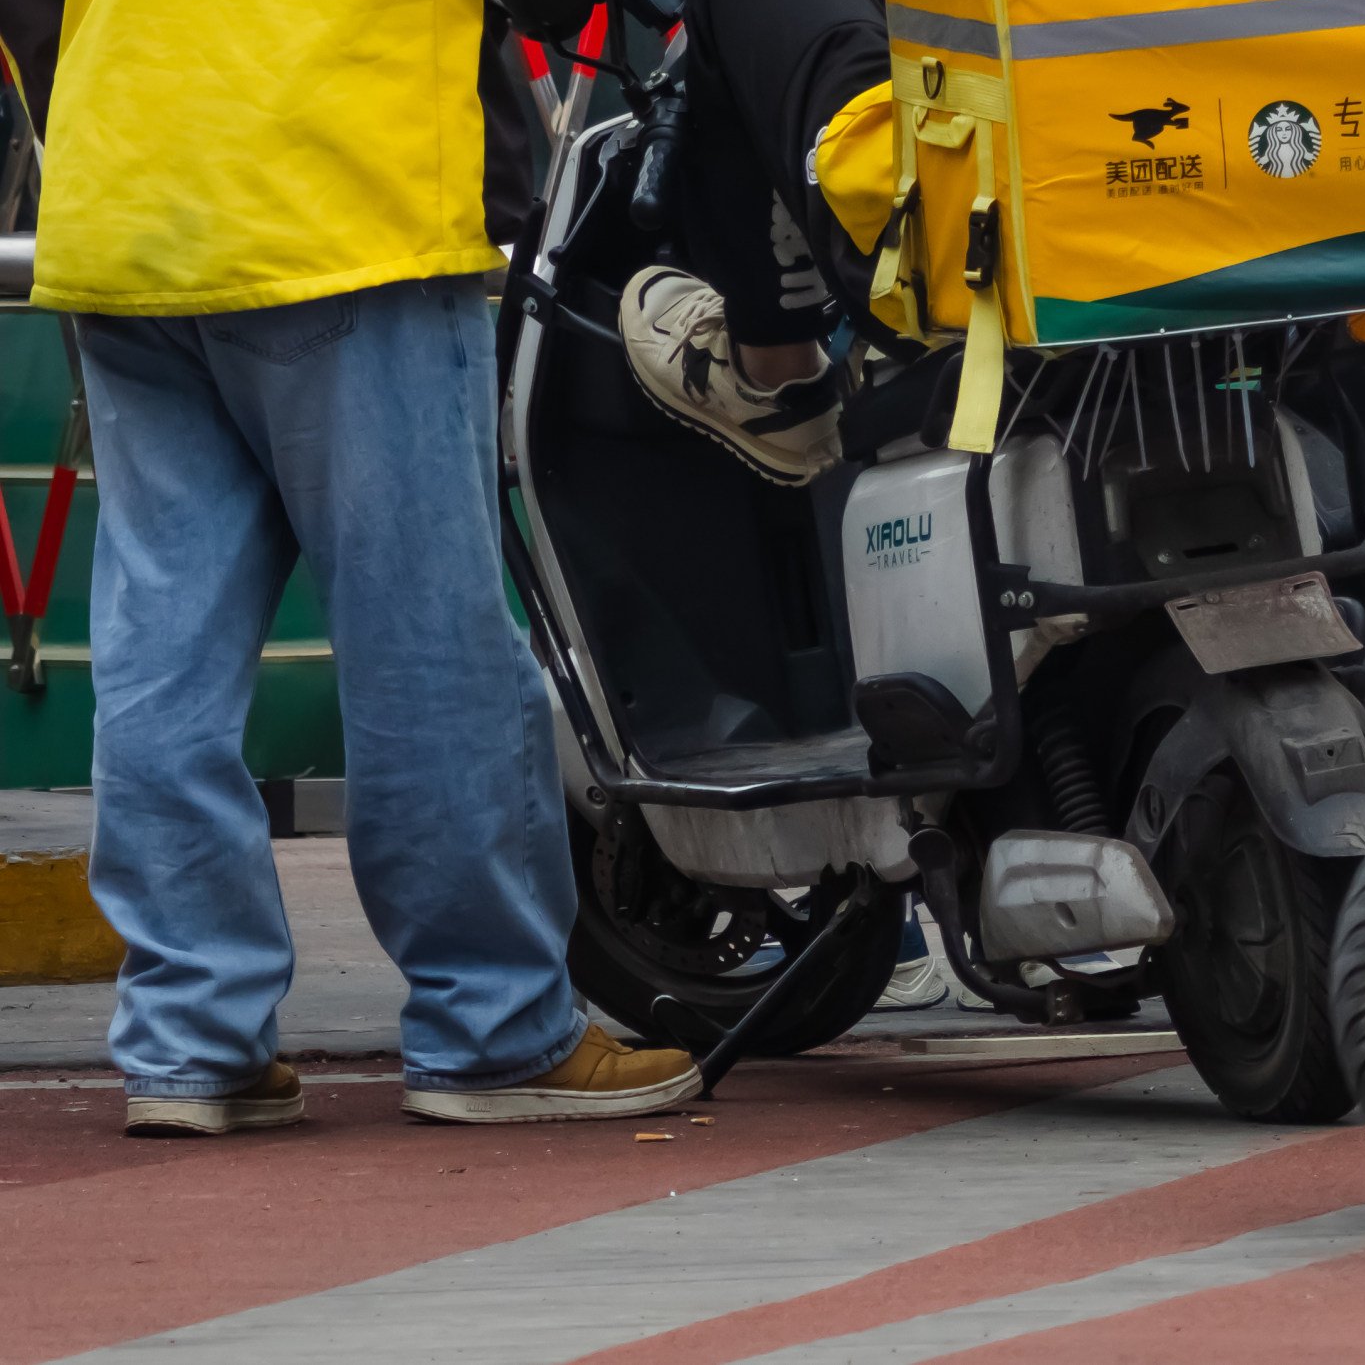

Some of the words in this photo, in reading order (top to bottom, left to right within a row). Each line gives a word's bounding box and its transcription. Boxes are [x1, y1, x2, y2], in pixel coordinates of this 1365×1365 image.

[1105, 154, 1204, 186] 美团配送
[866, 512, 932, 555] XIAOLU
[876, 547, 920, 571] TRAVEL
